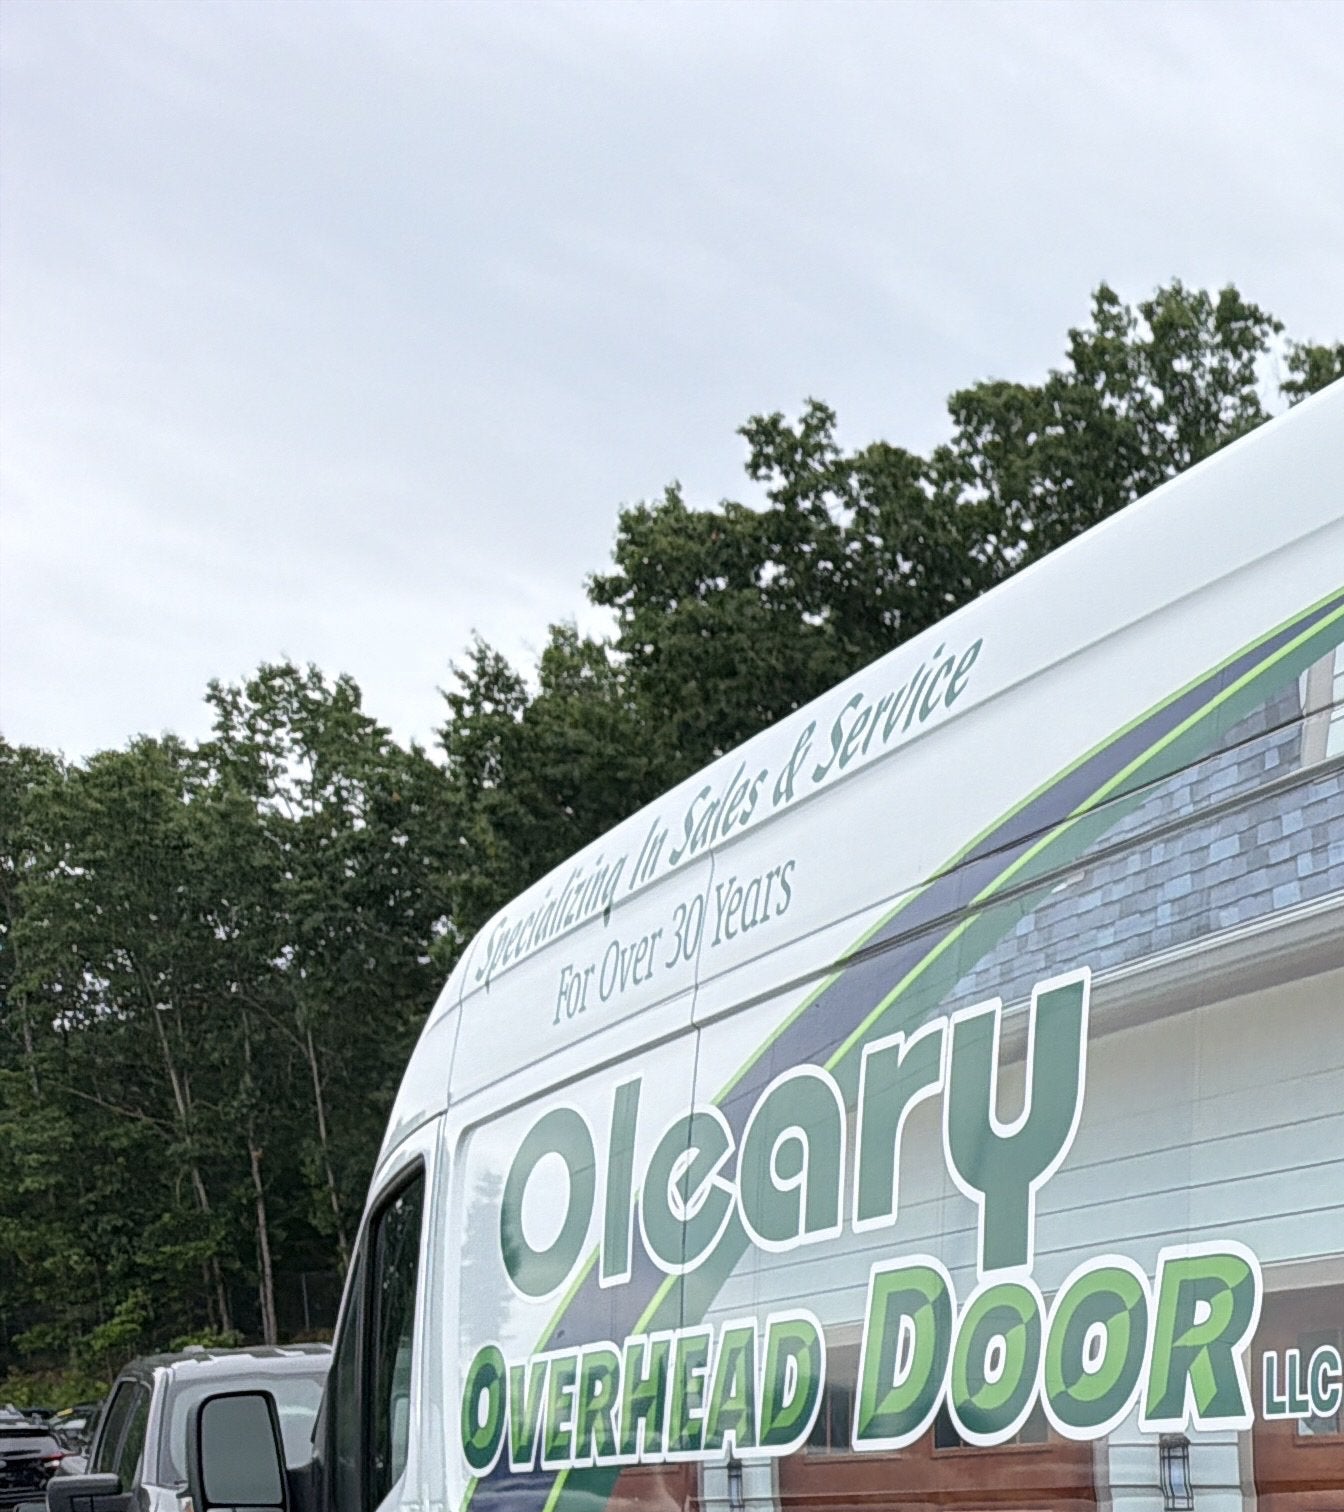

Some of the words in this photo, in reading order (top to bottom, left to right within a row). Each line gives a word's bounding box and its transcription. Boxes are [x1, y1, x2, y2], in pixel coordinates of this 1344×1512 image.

[475, 852, 628, 993] Specializing
[628, 815, 668, 890] In
[669, 761, 768, 866] Sales
[773, 719, 816, 807] &
[812, 637, 984, 783] Service
[552, 962, 595, 1026] For
[598, 931, 664, 1002] Over
[665, 893, 703, 969] 30
[710, 859, 795, 947] Years
[500, 967, 1092, 1304] Oleary
[459, 1309, 827, 1478] OVERHEAD
[851, 1240, 1265, 1452] DOOR
[1262, 1344, 1344, 1421] LLC
